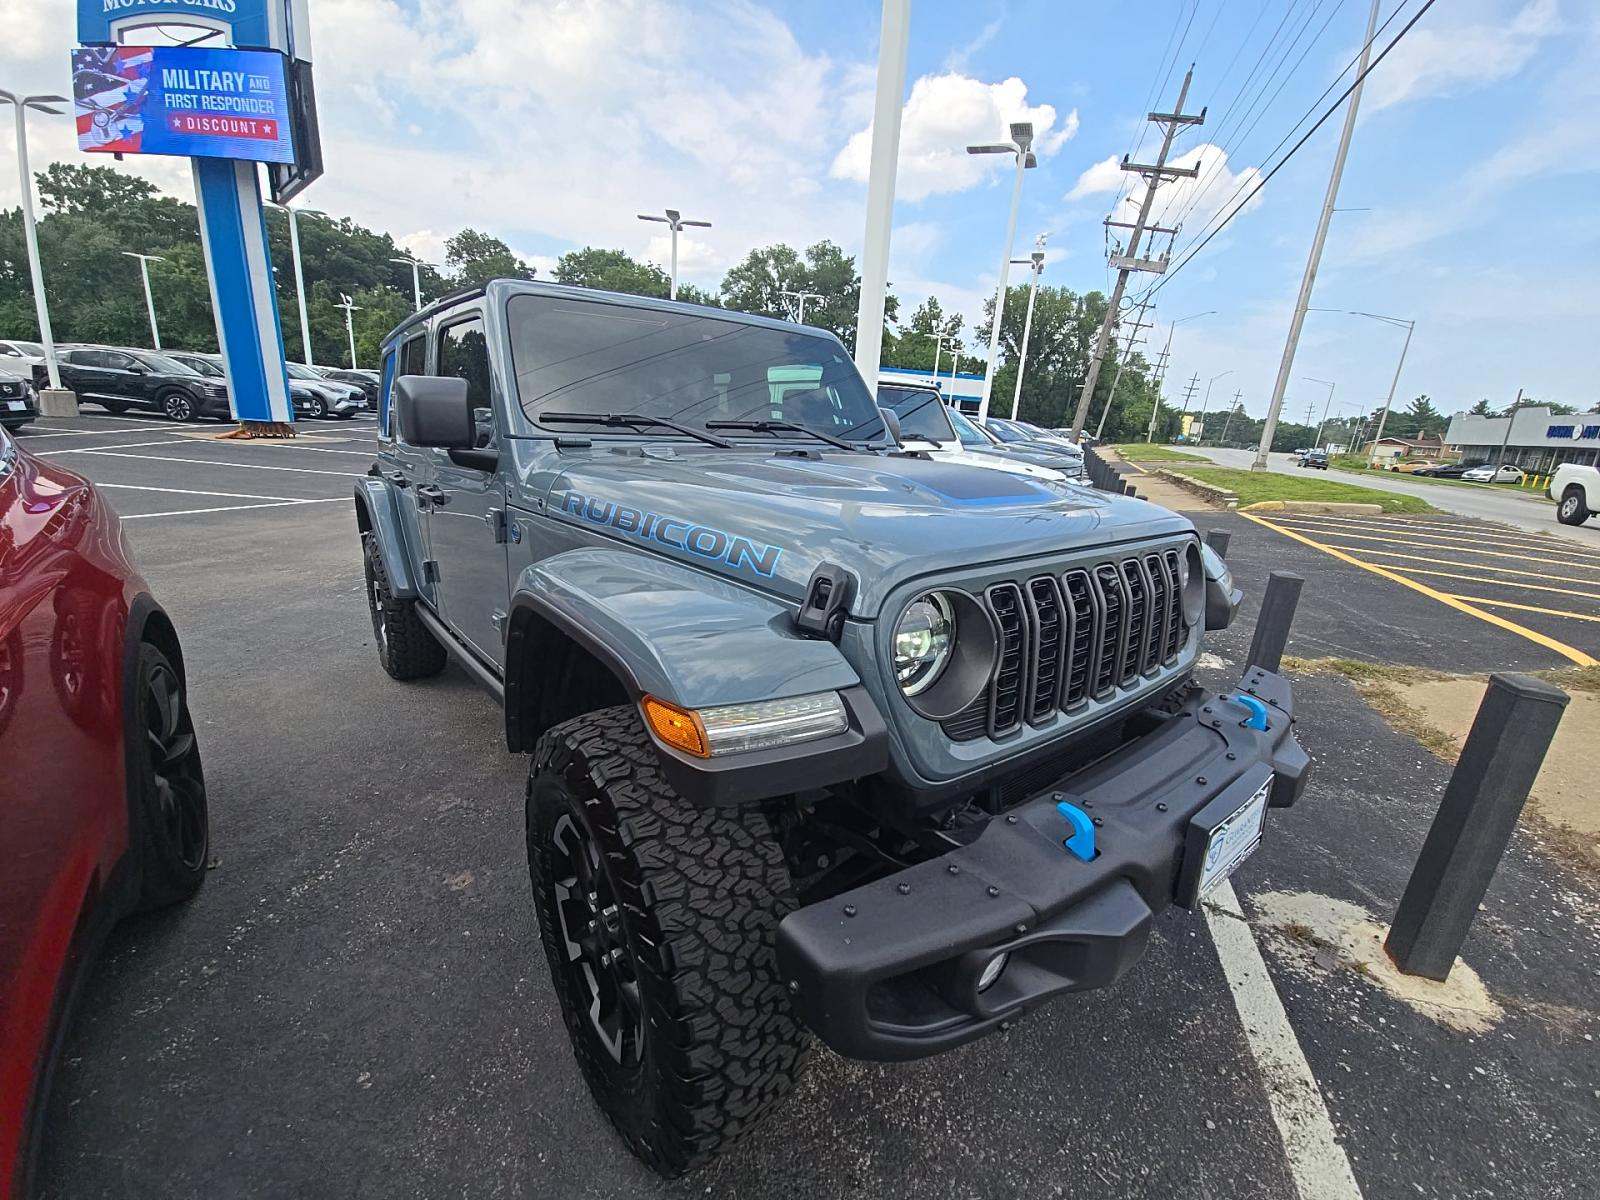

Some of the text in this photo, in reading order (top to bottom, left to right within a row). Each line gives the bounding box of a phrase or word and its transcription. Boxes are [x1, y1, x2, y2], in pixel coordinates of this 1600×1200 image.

[162, 68, 270, 92] MILITARY AND
[164, 93, 275, 114] FIRST RESPONDER
[186, 117, 256, 134] DISCOUNT
[560, 490, 784, 578] RUBICON
